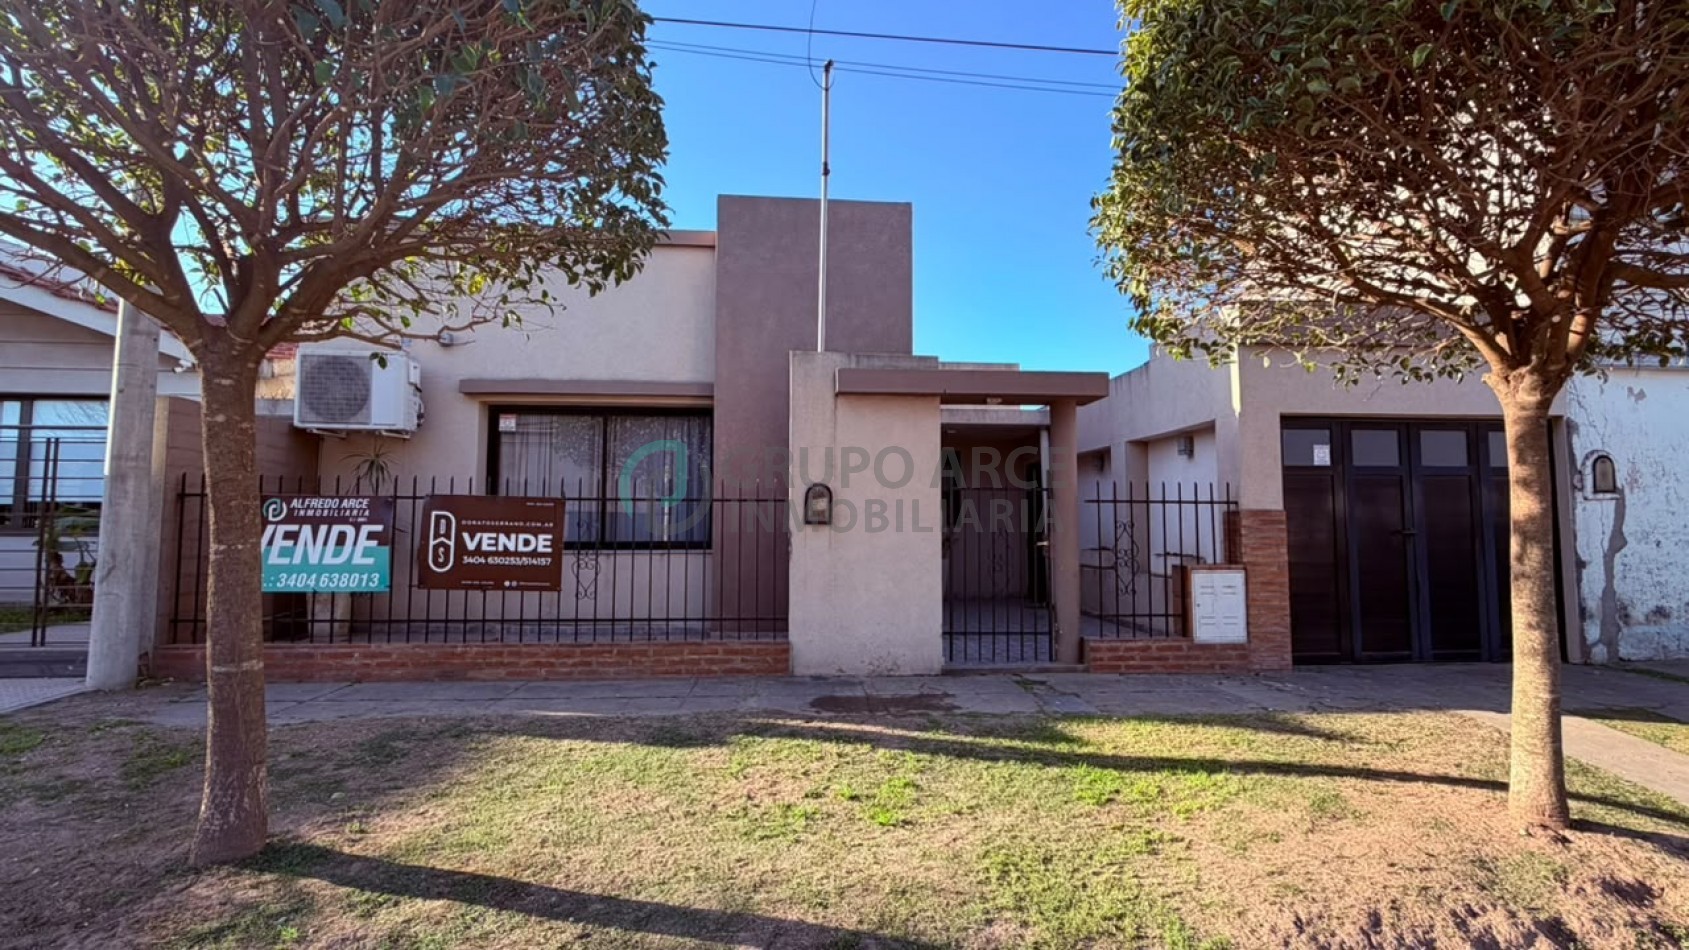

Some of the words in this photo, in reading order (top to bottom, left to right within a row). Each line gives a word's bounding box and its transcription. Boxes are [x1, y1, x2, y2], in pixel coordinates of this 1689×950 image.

[290, 498, 339, 509] ALFREDO
[340, 498, 370, 509] ARCE
[294, 509, 370, 517] INMOBILIARIA
[462, 532, 553, 553] VENDE
[462, 555, 486, 564] 3404
[487, 556, 552, 566] 630253/514157
[276, 573, 318, 588] 3404
[319, 573, 380, 588] 638013
